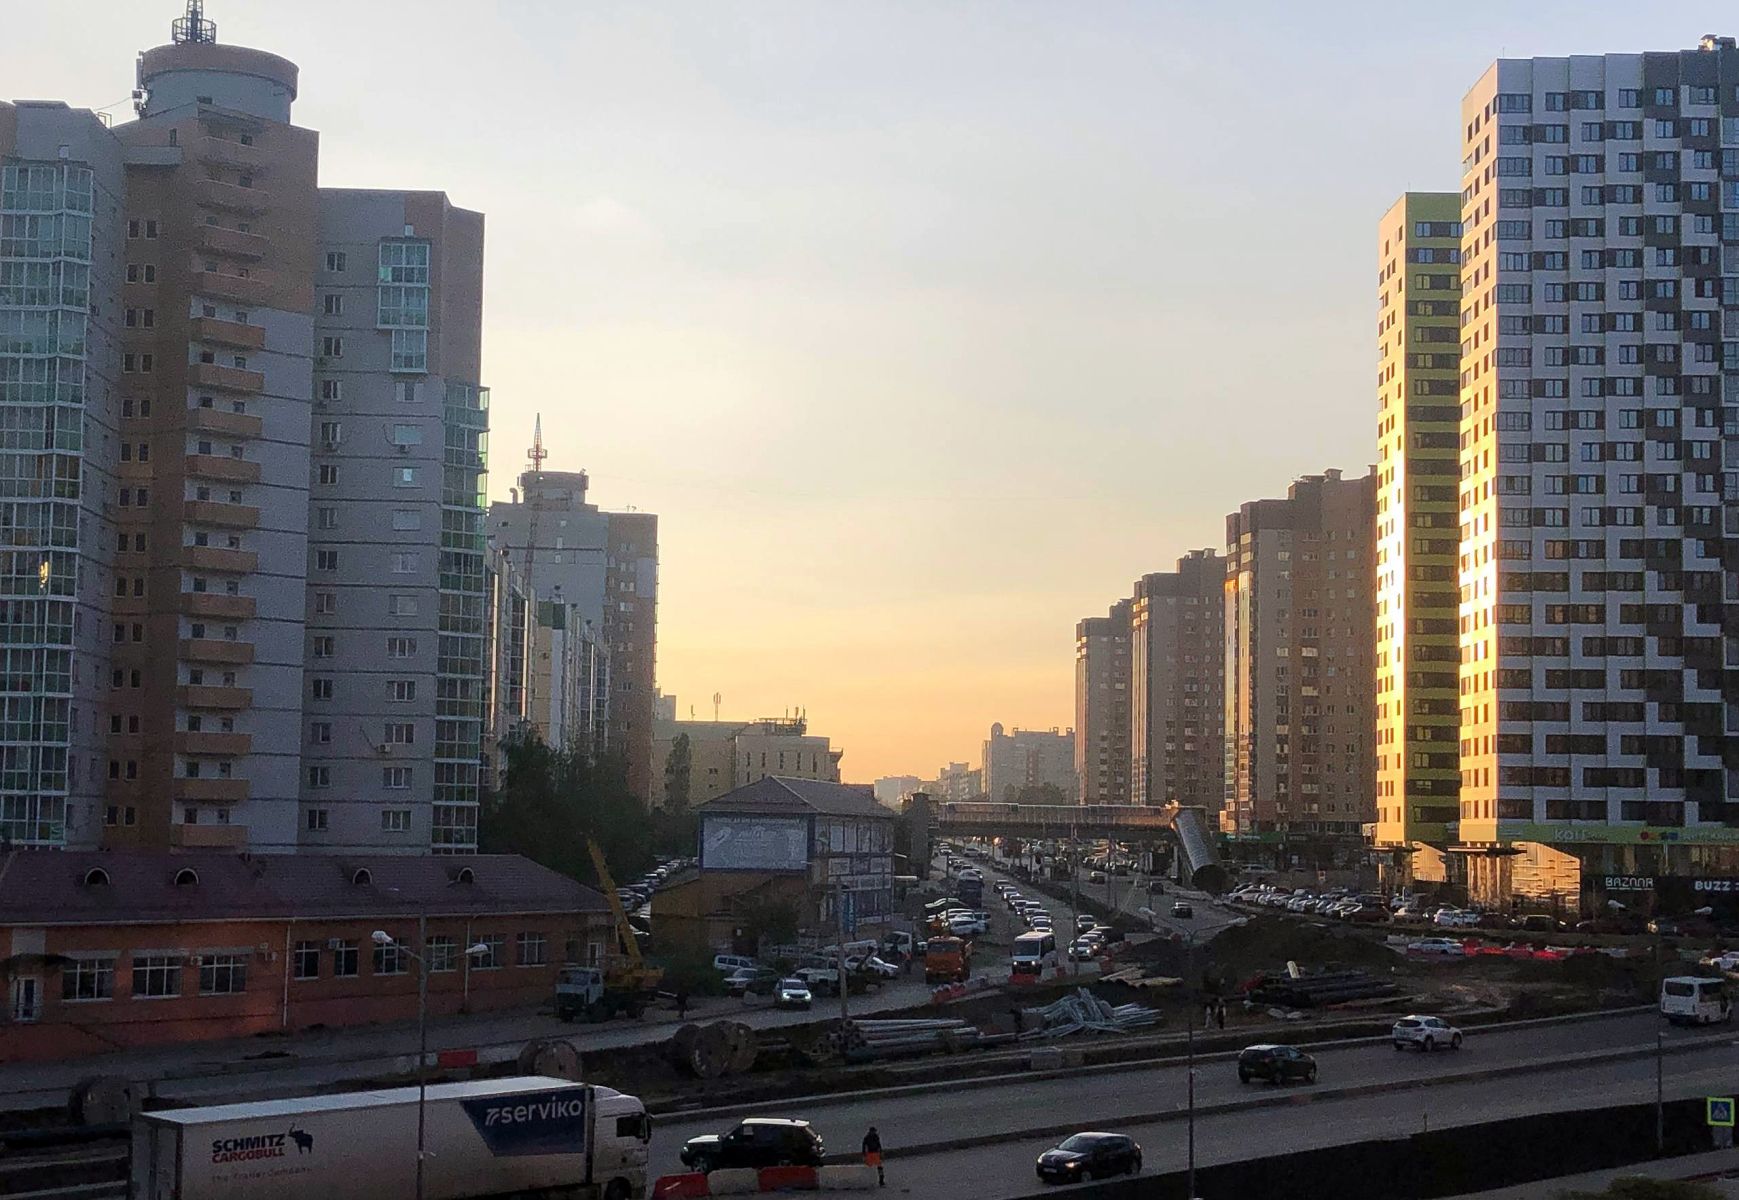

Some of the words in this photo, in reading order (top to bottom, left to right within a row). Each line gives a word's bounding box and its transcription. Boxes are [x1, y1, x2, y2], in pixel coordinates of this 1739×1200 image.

[1694, 880, 1731, 891] BUZZ
[501, 1095, 583, 1124] serviko
[212, 1133, 286, 1154] SCHMITZ
[212, 1147, 286, 1164] CARGOBULL
